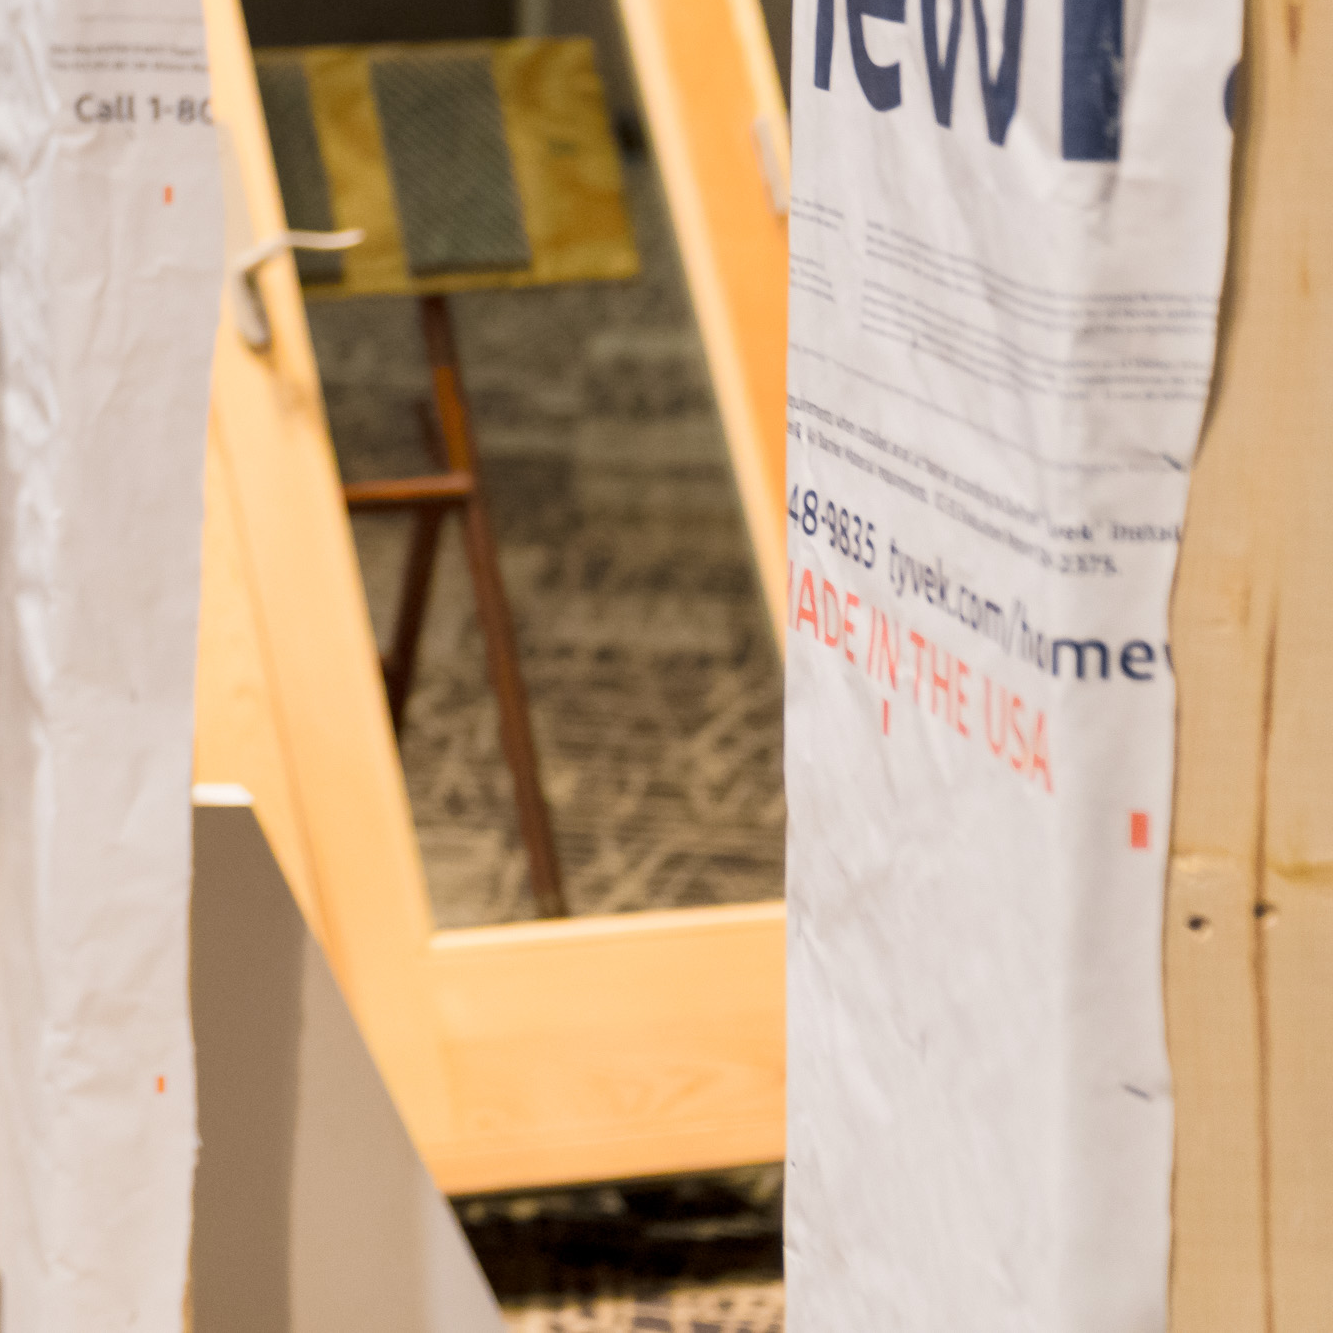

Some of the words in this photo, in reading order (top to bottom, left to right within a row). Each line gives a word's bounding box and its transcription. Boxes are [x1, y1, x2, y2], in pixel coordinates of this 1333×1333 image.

[74, 91, 136, 125] Call
[866, 603, 902, 691] IN
[909, 628, 972, 739] THE
[983, 672, 1055, 794] USA
